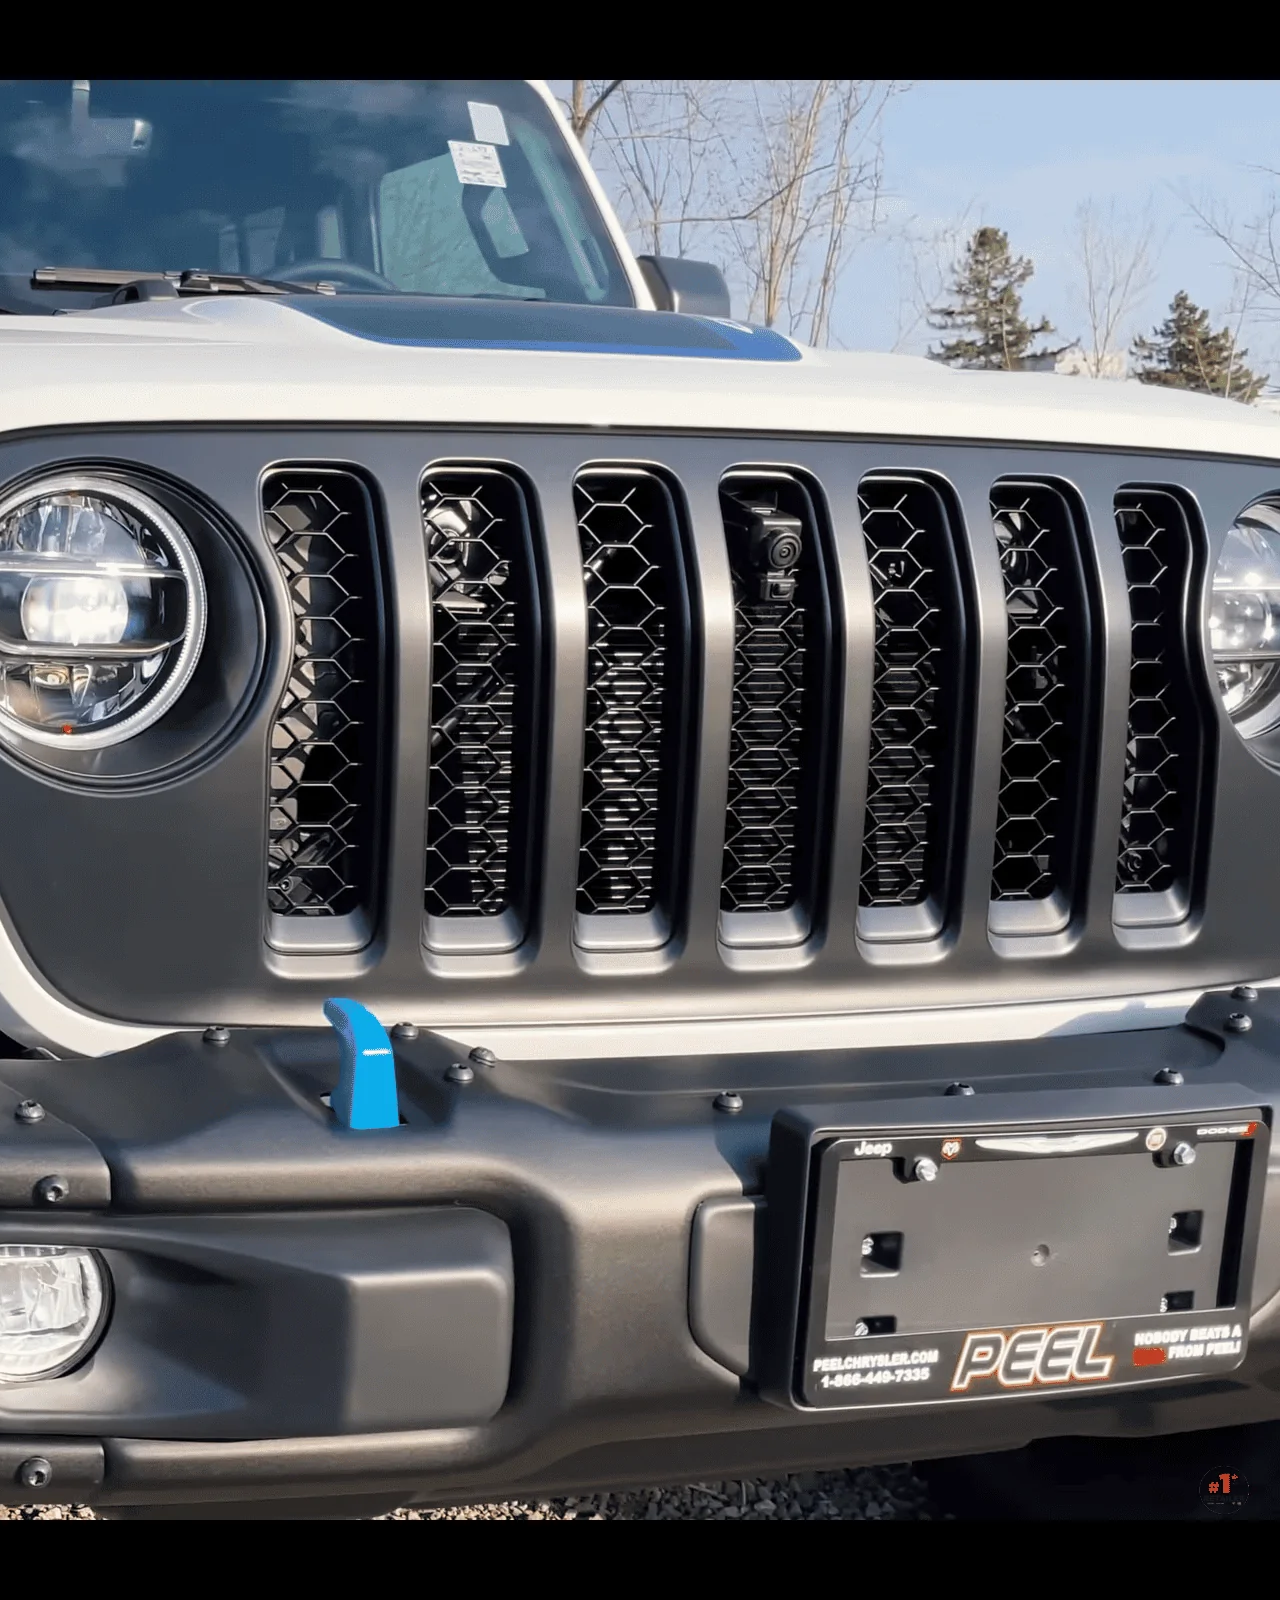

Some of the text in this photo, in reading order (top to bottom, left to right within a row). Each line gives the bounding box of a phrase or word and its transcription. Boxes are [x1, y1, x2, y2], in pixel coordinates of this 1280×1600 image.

[854, 1140, 893, 1157] Jeep
[1134, 1330, 1188, 1346] NOBODY
[1231, 1324, 1242, 1338] A
[813, 1348, 939, 1372] PEELCHRYSLER.COM
[950, 1322, 1115, 1392] PEEL
[1168, 1343, 1204, 1359] FROM
[821, 1366, 931, 1388] 1-866-449-7335
